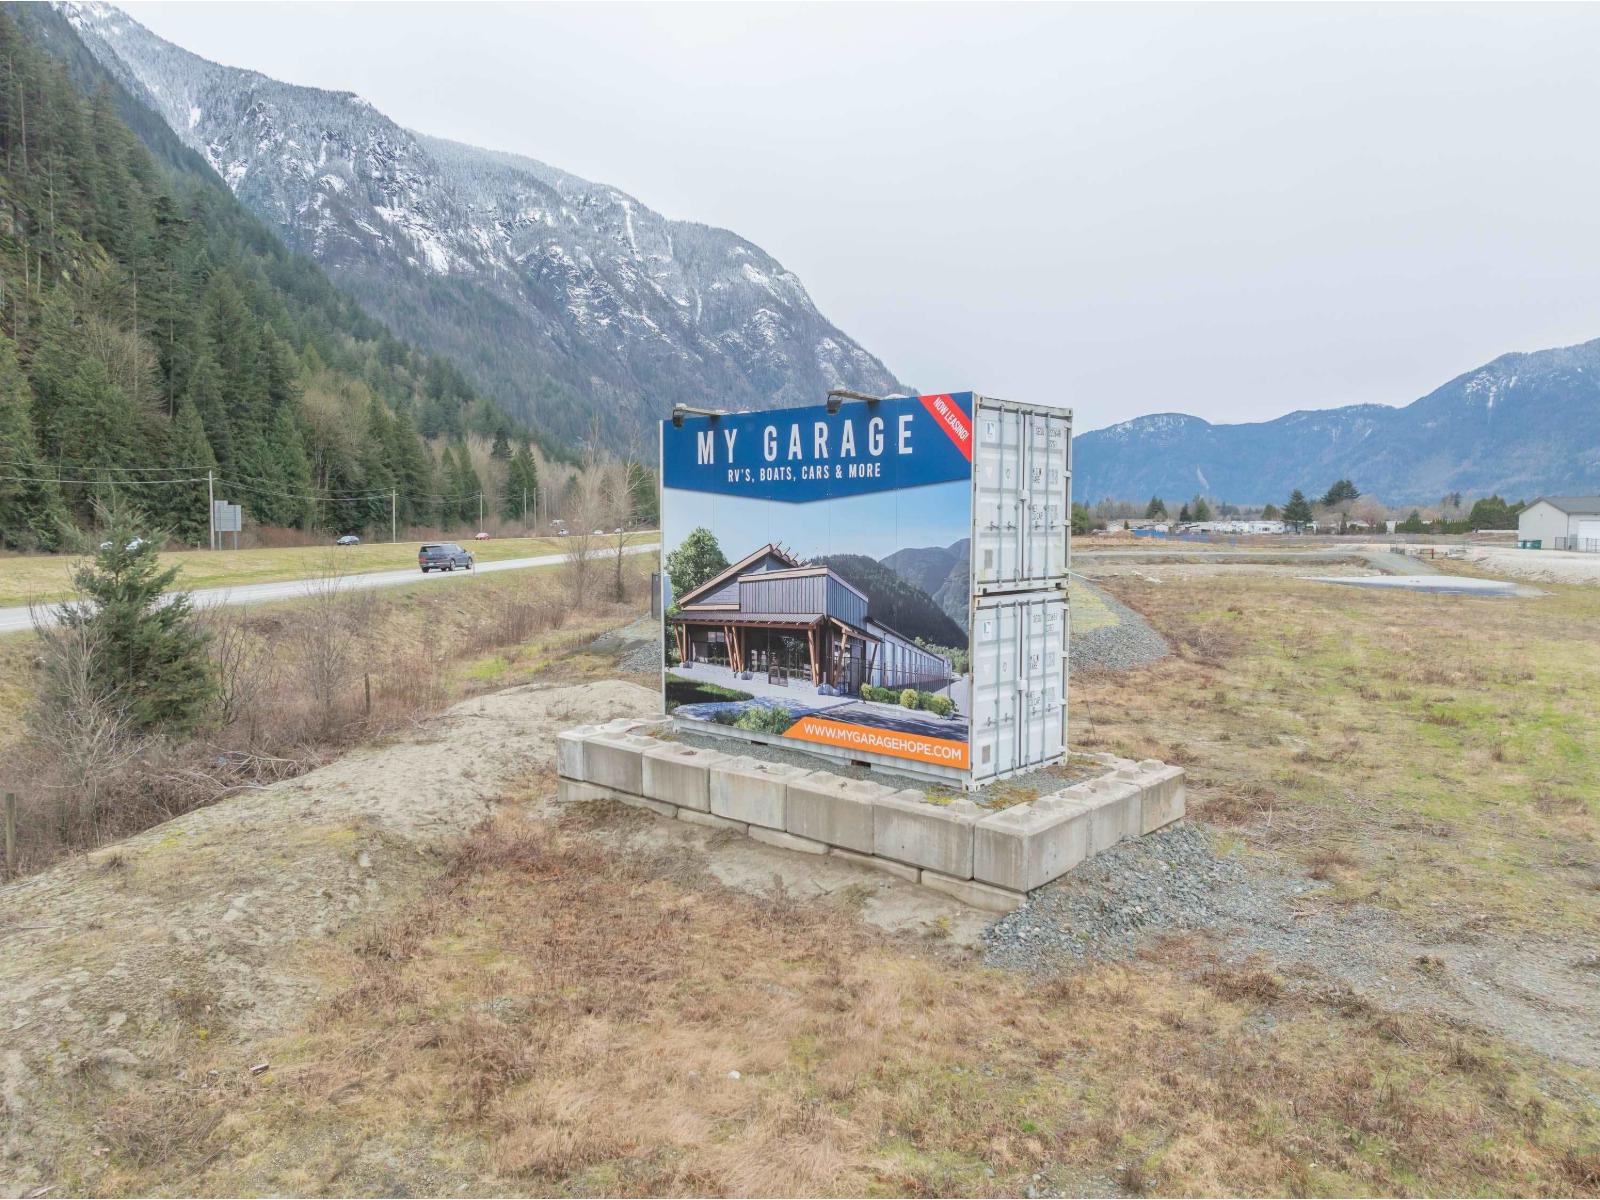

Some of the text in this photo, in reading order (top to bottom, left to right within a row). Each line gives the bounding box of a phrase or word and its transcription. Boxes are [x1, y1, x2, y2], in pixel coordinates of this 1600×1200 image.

[933, 396, 970, 441] NOW LEASING!
[697, 414, 914, 465] MY GARAGE
[728, 462, 882, 483] RV'S, BOATS, CARS & MORE
[804, 723, 962, 761] WWW.MYGARAGEHOPE.COM
